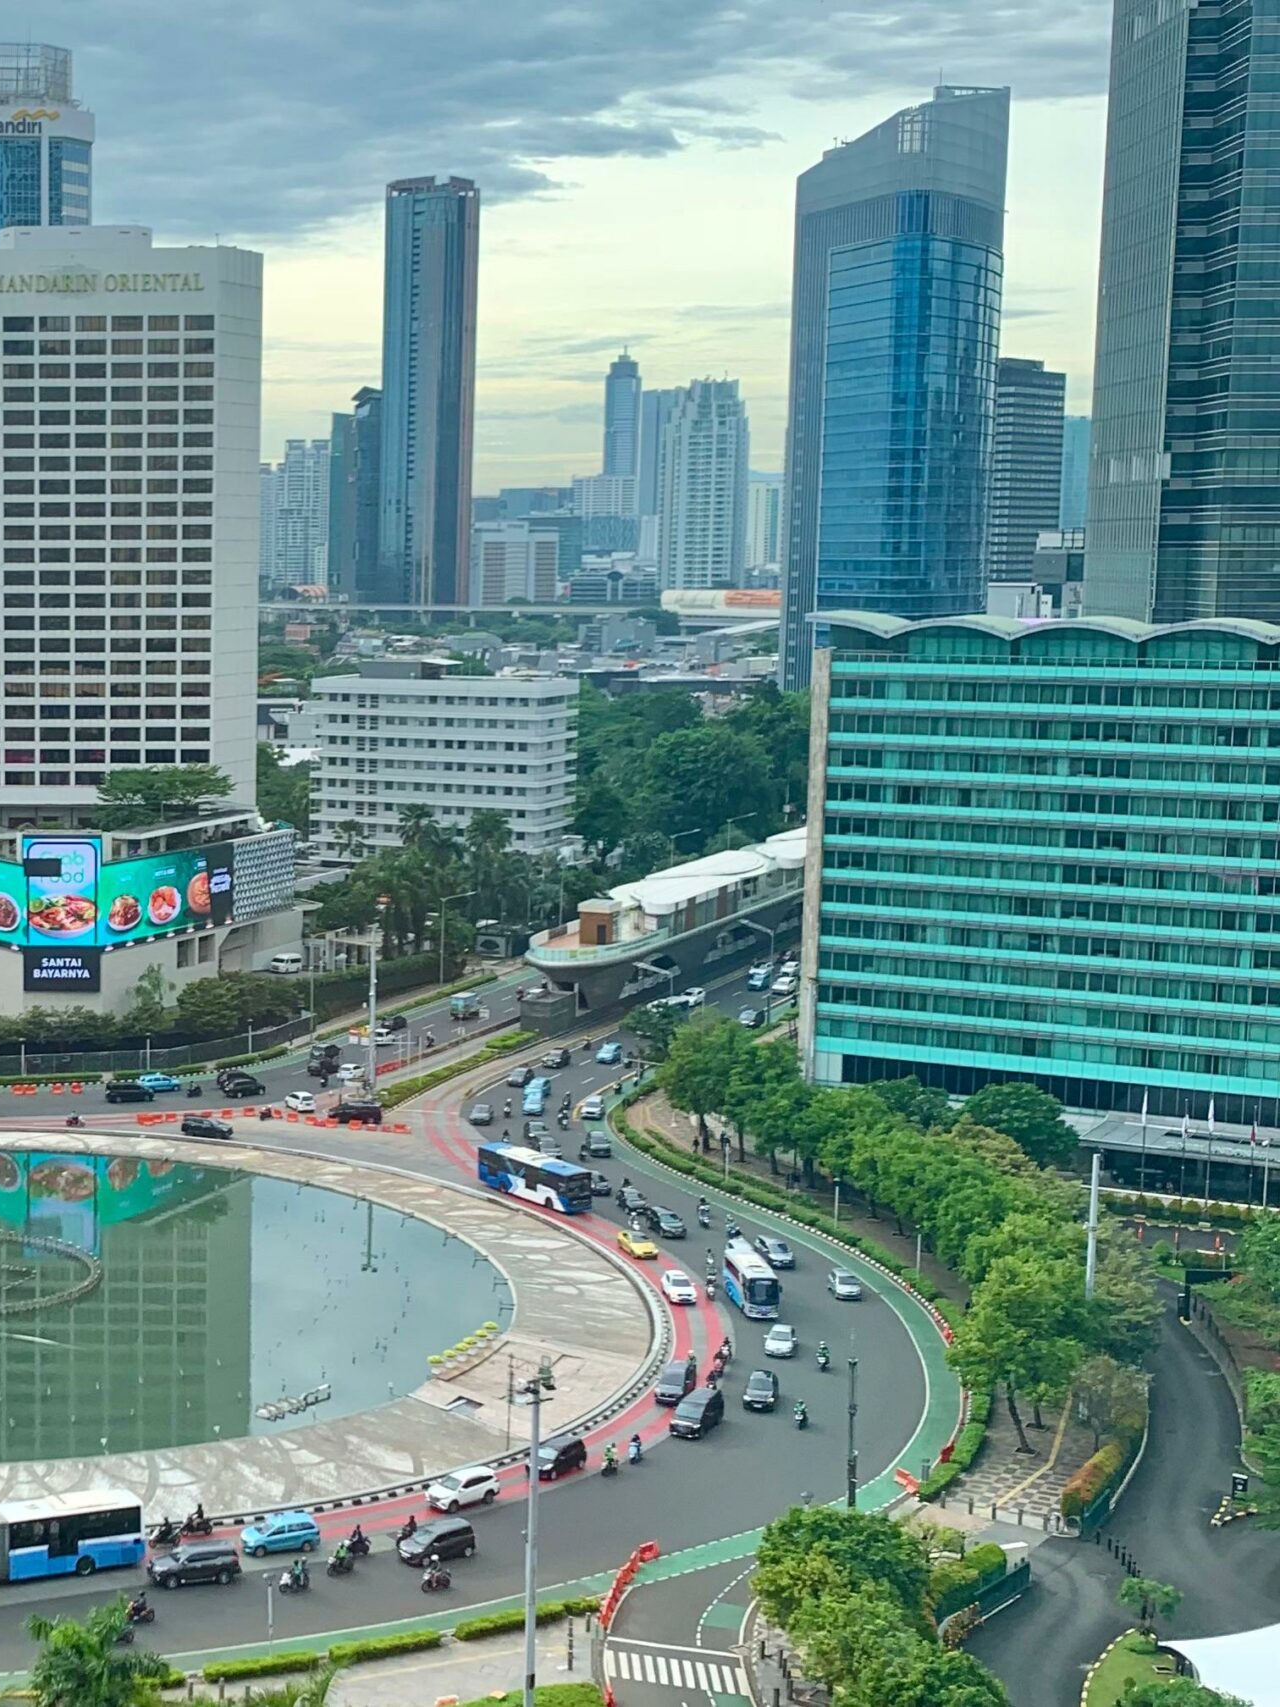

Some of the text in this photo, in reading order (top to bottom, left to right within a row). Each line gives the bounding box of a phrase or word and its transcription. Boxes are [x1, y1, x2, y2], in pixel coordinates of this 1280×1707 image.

[104, 272, 205, 292] ORIENTAL
[41, 957, 82, 967] SANTAI
[33, 968, 90, 979] BAYARNYA
